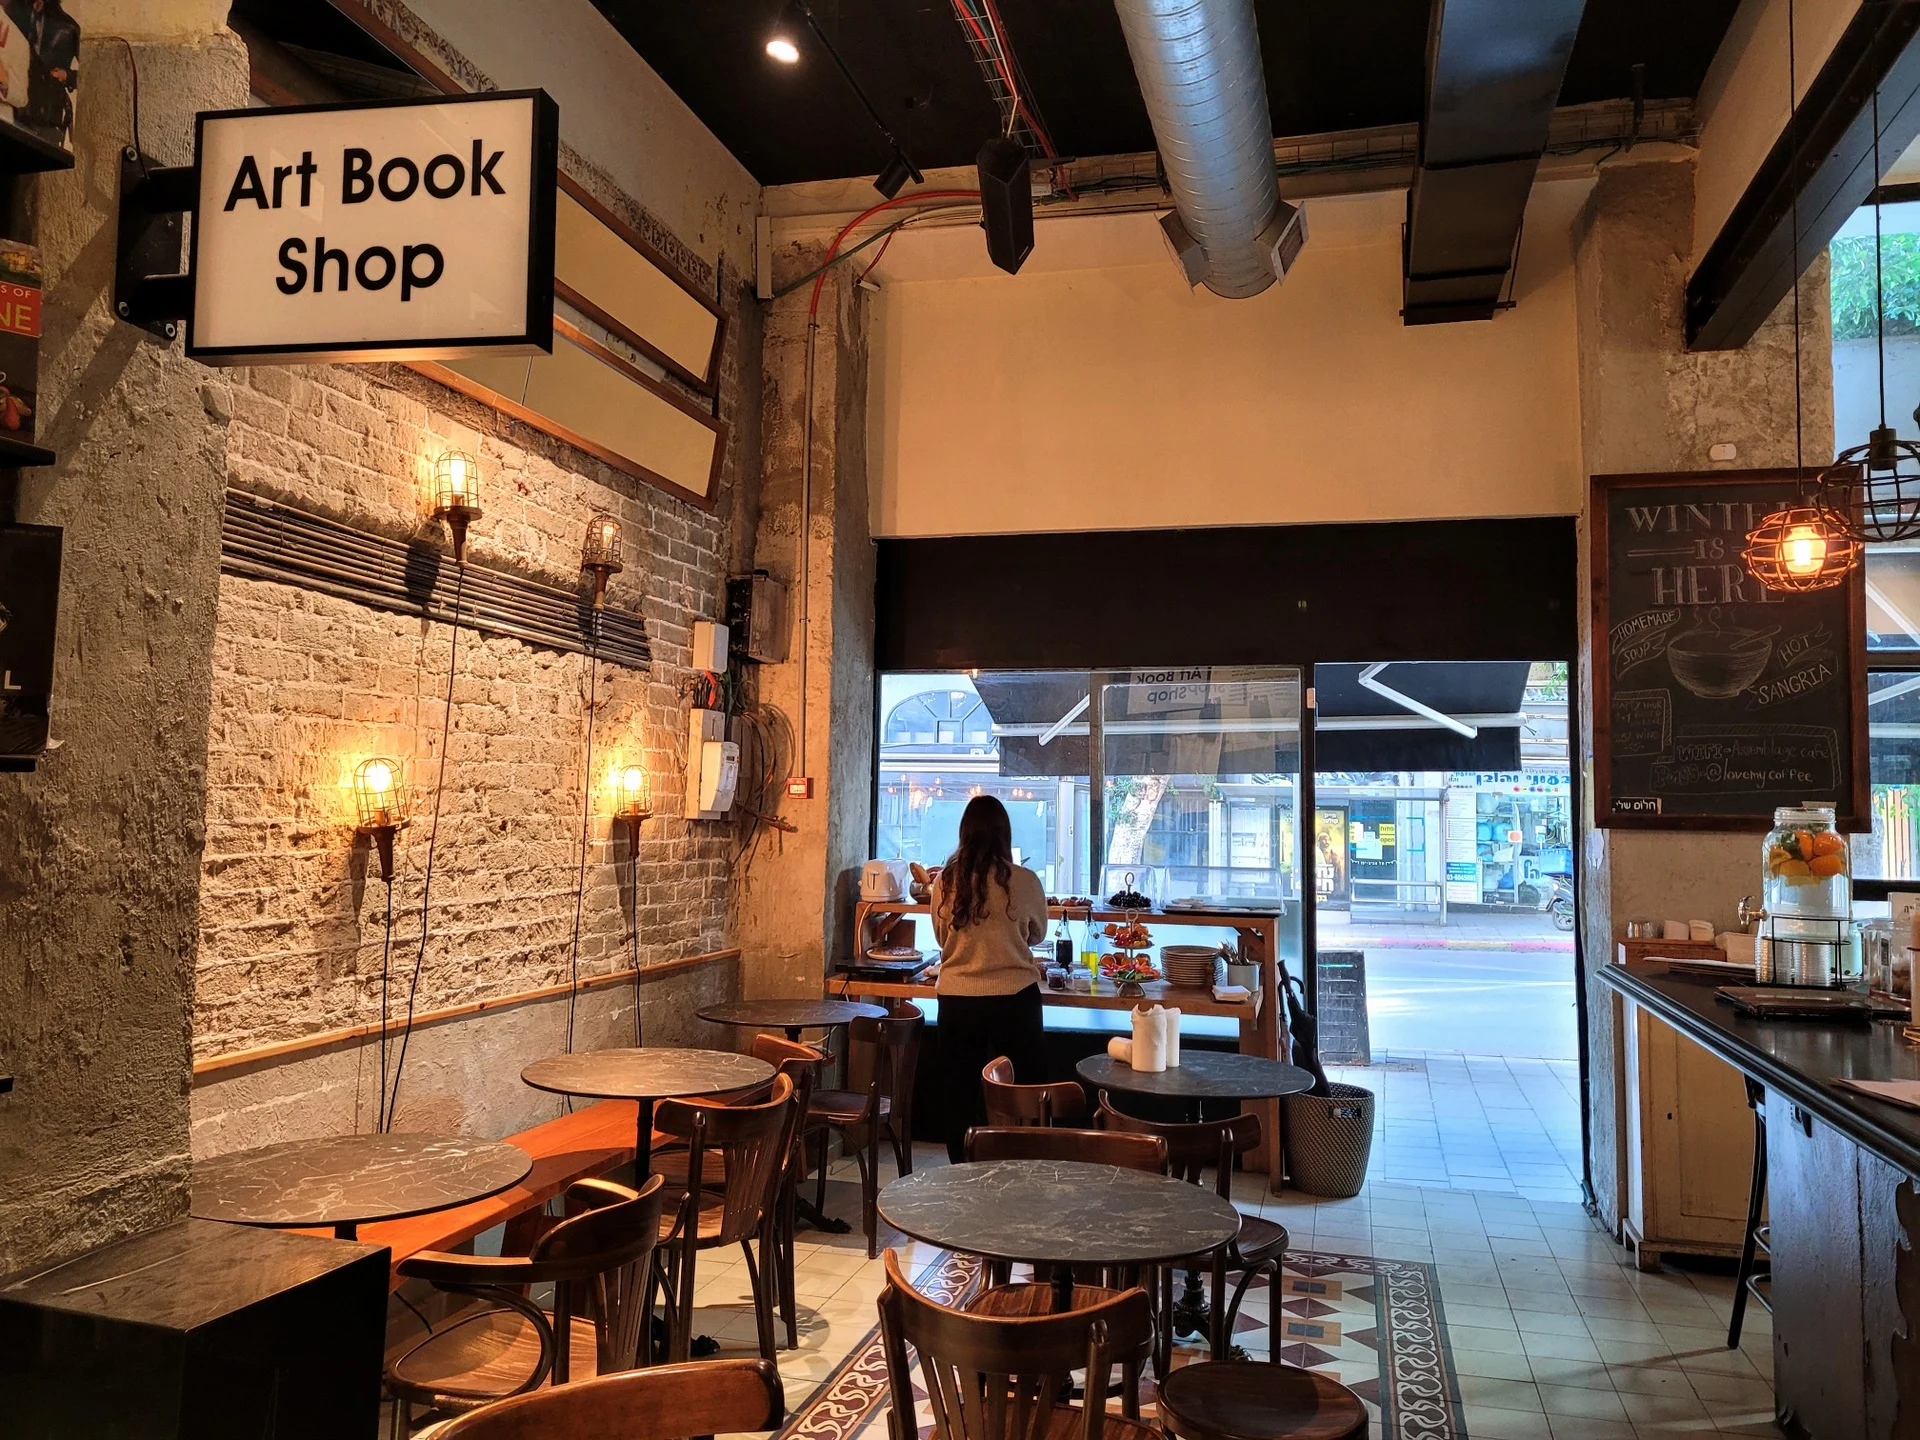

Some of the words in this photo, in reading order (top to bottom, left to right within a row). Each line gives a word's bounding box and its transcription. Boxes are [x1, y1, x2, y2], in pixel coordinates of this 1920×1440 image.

[223, 151, 317, 212] Art
[342, 138, 506, 205] Book
[276, 236, 444, 302] Shop
[13, 287, 32, 298] OF
[1694, 537, 1725, 560] IS
[1617, 611, 1677, 641] HOMEMADE
[1622, 642, 1651, 665] SOUP
[1780, 634, 1812, 662] HOT
[1757, 663, 1833, 706] SANGRIA
